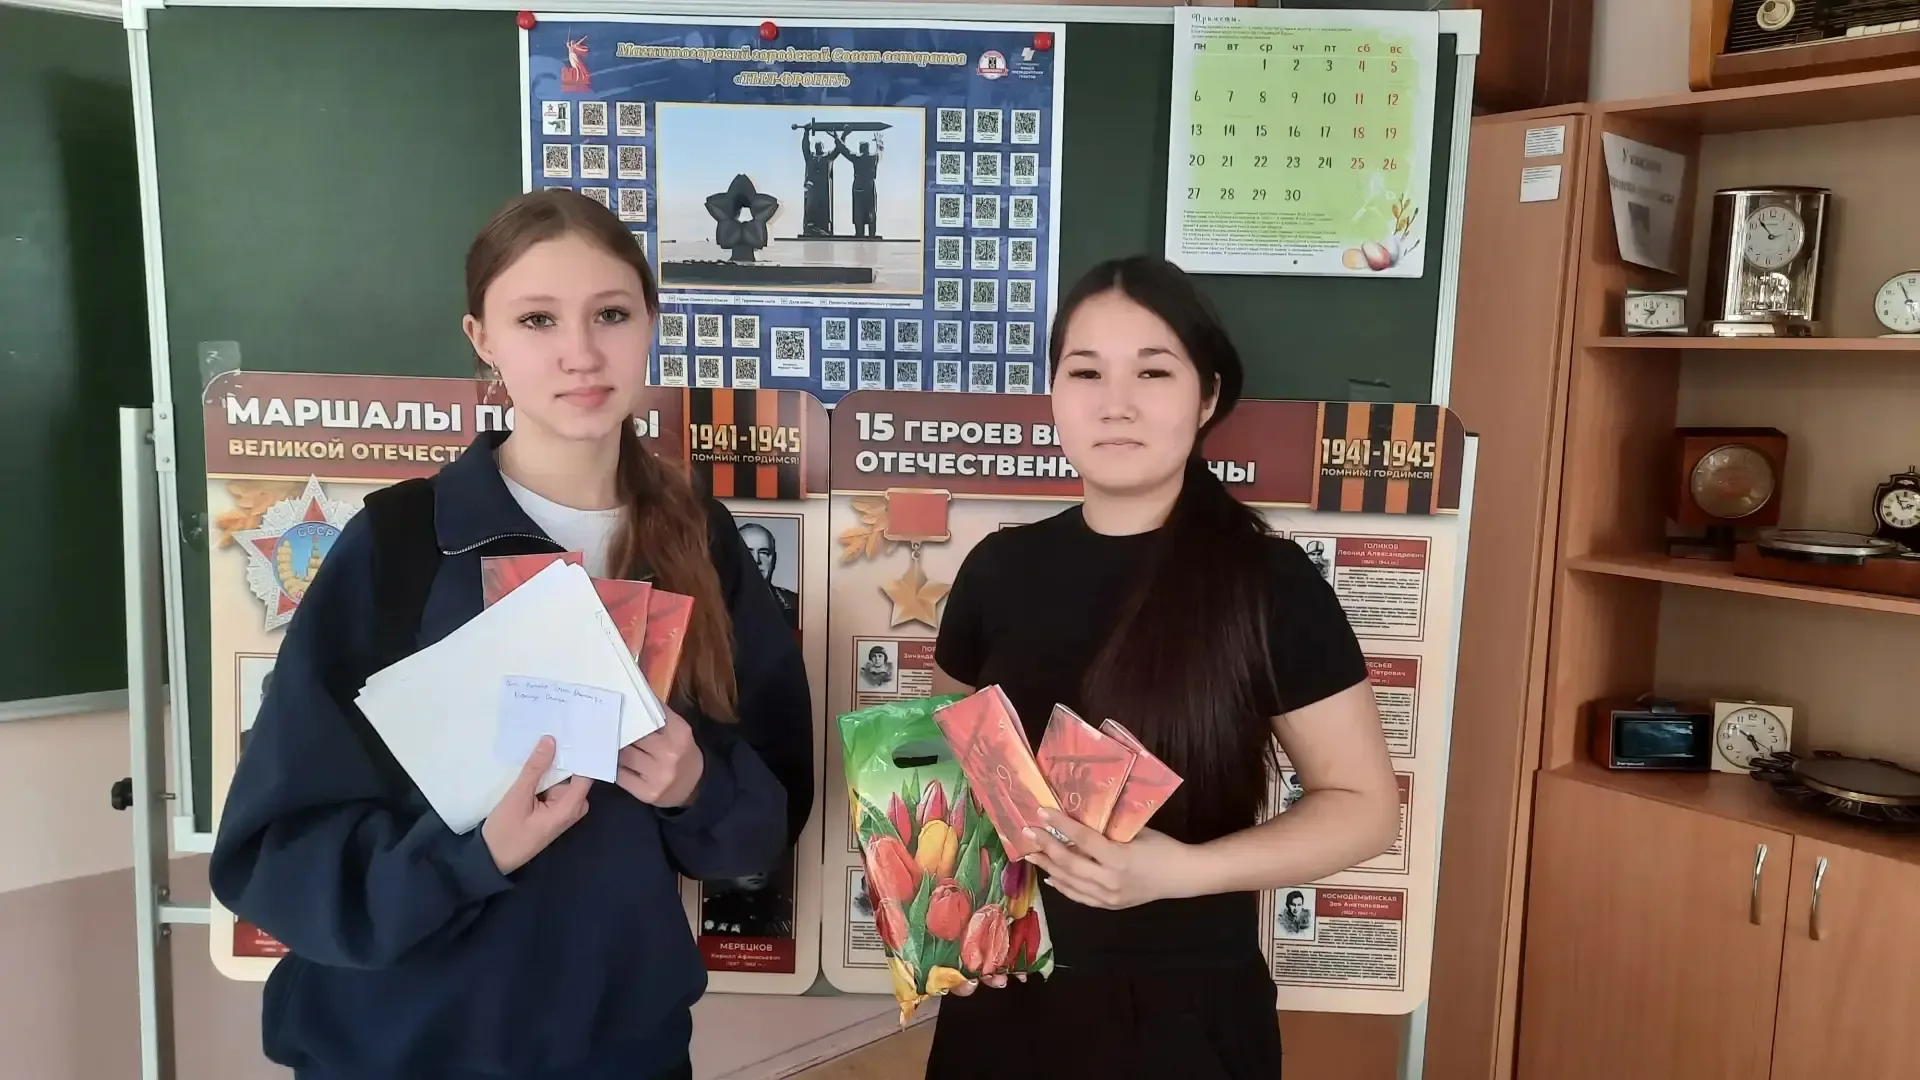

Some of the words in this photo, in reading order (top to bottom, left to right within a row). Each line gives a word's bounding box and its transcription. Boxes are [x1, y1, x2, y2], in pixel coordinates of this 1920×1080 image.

[616, 43, 751, 63] Магнитогорский
[752, 46, 830, 64] городской
[831, 48, 882, 63] Совет
[882, 51, 967, 67] ветеранов
[1260, 44, 1272, 53] ср
[1358, 44, 1370, 52] сб
[1263, 59, 1266, 70] 1
[1293, 59, 1299, 71] 2
[1326, 60, 1332, 71] 3
[1359, 61, 1365, 72] 4
[1391, 61, 1397, 73] 5
[1195, 90, 1201, 101] 6
[1228, 91, 1234, 102] 7
[1260, 91, 1266, 103] 8
[1292, 92, 1298, 103] 9
[1323, 92, 1336, 104] 10
[1355, 93, 1363, 104] 11
[1388, 94, 1398, 105] 12
[1191, 124, 1202, 136] 13
[1224, 124, 1235, 136] 14
[1256, 125, 1267, 136] 15
[1289, 126, 1300, 137] 16
[1321, 126, 1331, 138] 17
[1353, 127, 1365, 138] 18
[1386, 128, 1397, 139] 19
[1189, 155, 1205, 166] 20
[1222, 156, 1233, 167] 21
[1254, 156, 1268, 168] 22
[1287, 156, 1300, 168] 23
[1318, 157, 1332, 168] 24
[1351, 158, 1365, 169] 25
[1383, 158, 1397, 170] 26
[1188, 188, 1200, 199] 27
[1221, 188, 1234, 199] 28
[1253, 189, 1266, 200] 29
[1285, 190, 1300, 201] 30
[227, 396, 462, 431] МАРШАЛЫ
[855, 412, 895, 441] 15
[904, 420, 1023, 444] ГЕРОЕВ
[690, 424, 800, 453] 1941-1945
[228, 437, 344, 459] ВЕЛИКОЙ
[1321, 438, 1435, 467] 1941-1945
[692, 454, 740, 463] ПОМНИМ!
[743, 455, 800, 464] ГОРДИМСЯ!
[1321, 468, 1371, 477] ПОМНИМ!
[1374, 469, 1433, 479] ГОРДИМСЯ!
[297, 525, 334, 537] СССР
[1337, 549, 1365, 557] Леонид
[996, 764, 1012, 790] 9
[1068, 792, 1081, 812] 9
[1322, 893, 1397, 901] КОСМОДЕМЬЯНСКАЯ
[720, 943, 773, 951] МЕРЕЦКОВ
